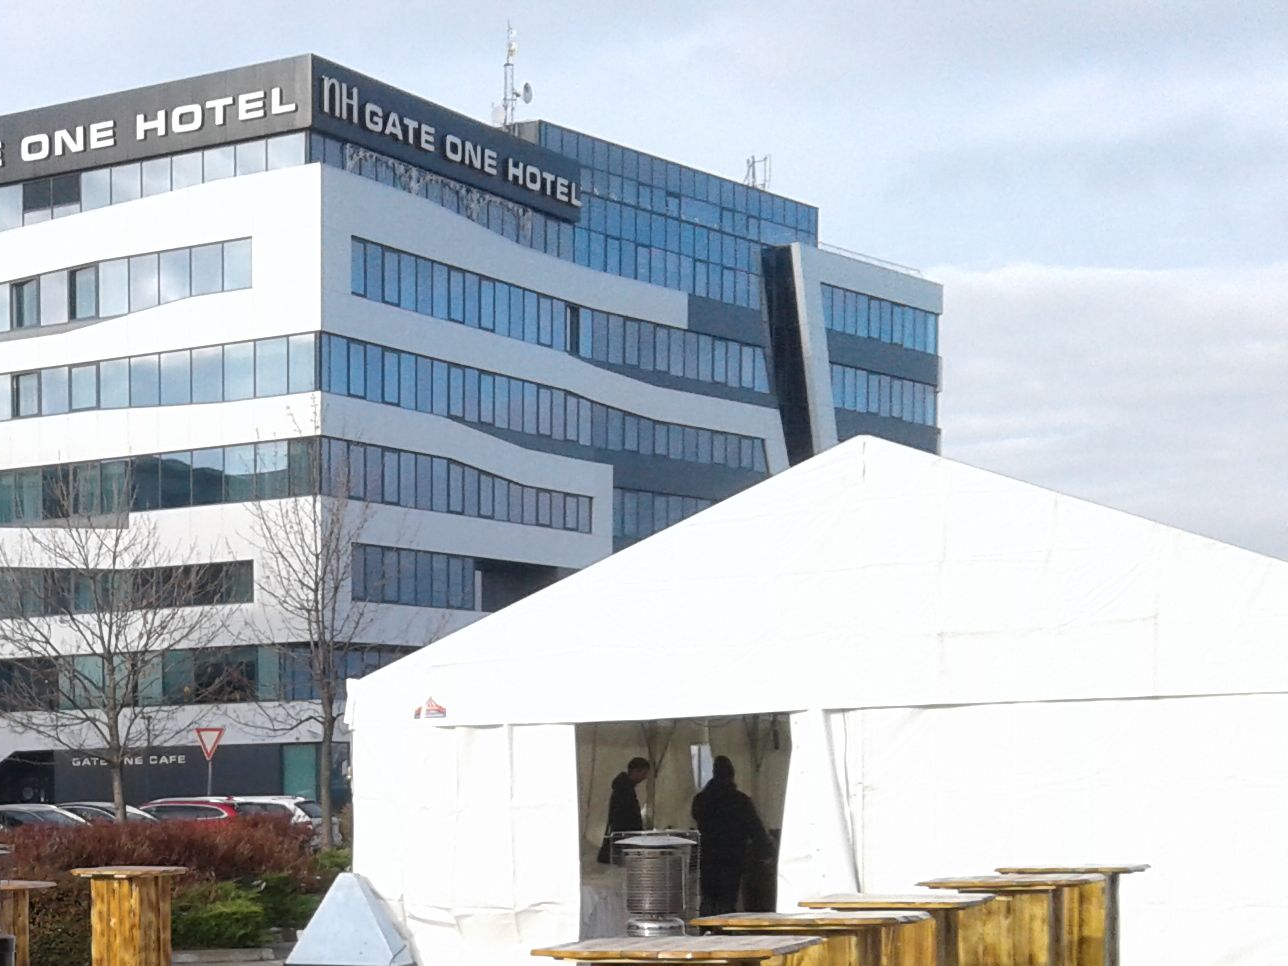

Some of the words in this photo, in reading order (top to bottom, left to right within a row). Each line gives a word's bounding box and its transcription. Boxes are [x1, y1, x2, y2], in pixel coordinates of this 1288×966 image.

[20, 120, 114, 162] ONE
[136, 86, 296, 140] HOTEL
[365, 102, 435, 152] GATE
[445, 134, 498, 176] ONE
[507, 157, 582, 207] HOTEL
[72, 757, 108, 766] GATE
[149, 755, 186, 764] CAFE
